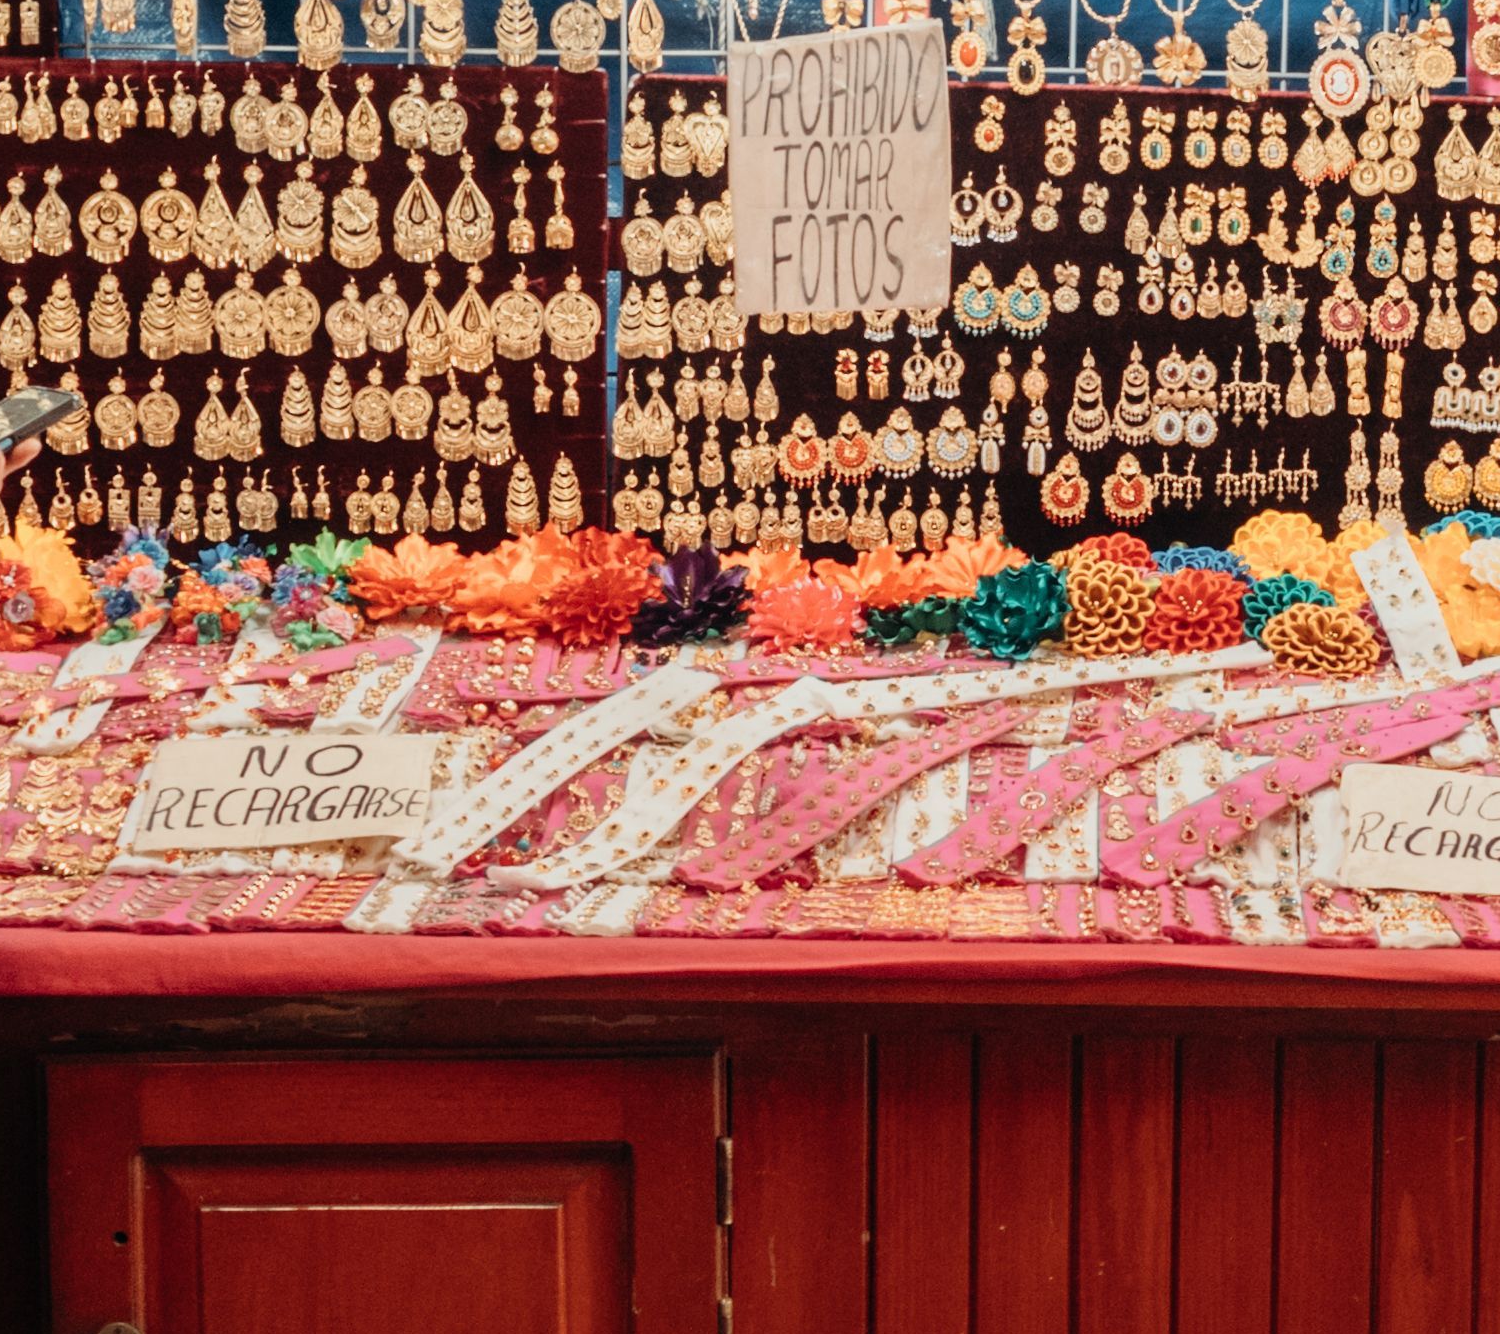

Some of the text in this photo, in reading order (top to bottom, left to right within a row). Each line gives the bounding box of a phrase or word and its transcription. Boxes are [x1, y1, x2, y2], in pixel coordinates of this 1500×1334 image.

[740, 31, 943, 138] PROHIBIDO
[773, 138, 895, 212] TOMAR
[771, 213, 906, 311] FOTOS
[238, 743, 365, 779] NO
[145, 784, 429, 833] RECARGARSE
